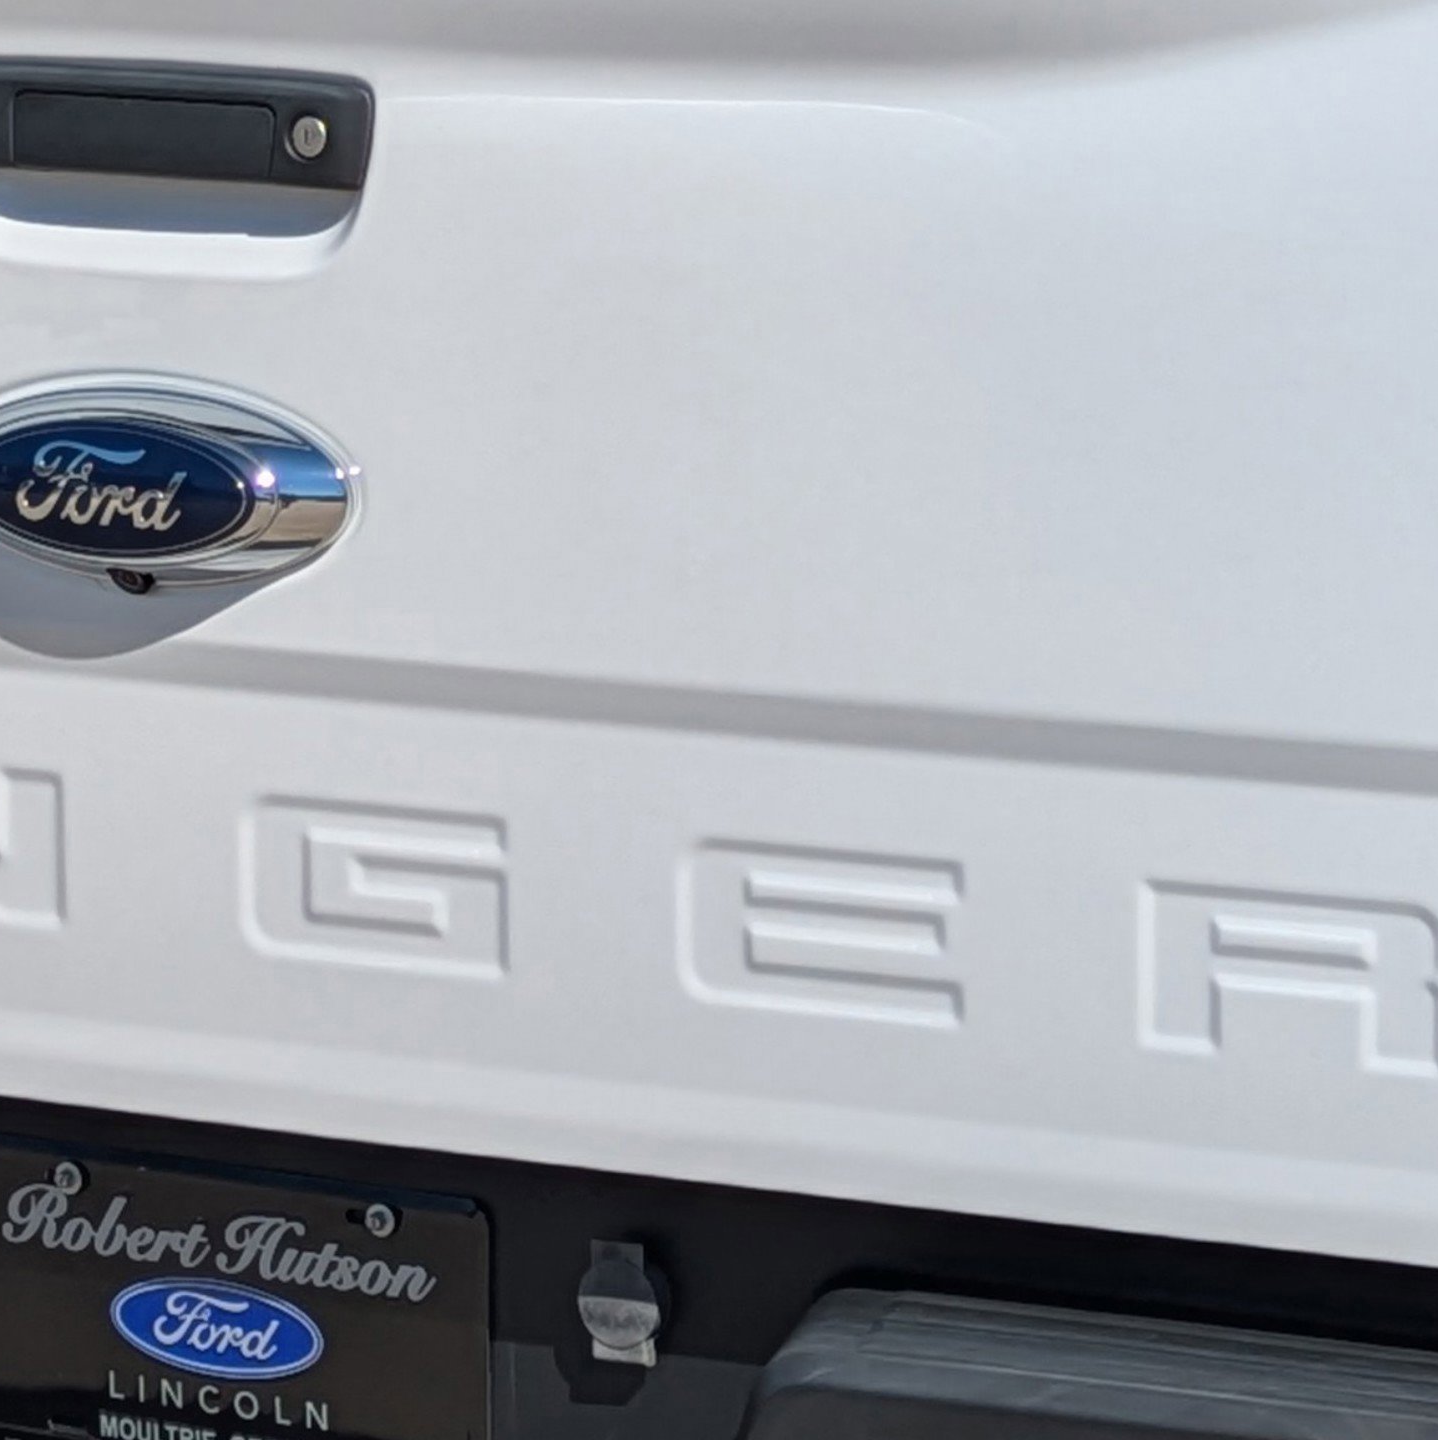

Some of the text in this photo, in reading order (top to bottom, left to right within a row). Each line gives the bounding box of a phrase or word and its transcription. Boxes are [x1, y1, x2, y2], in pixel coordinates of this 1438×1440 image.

[15, 440, 188, 532] Ford
[2, 1181, 437, 1303] Robert Hutson
[153, 1290, 281, 1362] Ford
[108, 1370, 330, 1432] LINCOLN
